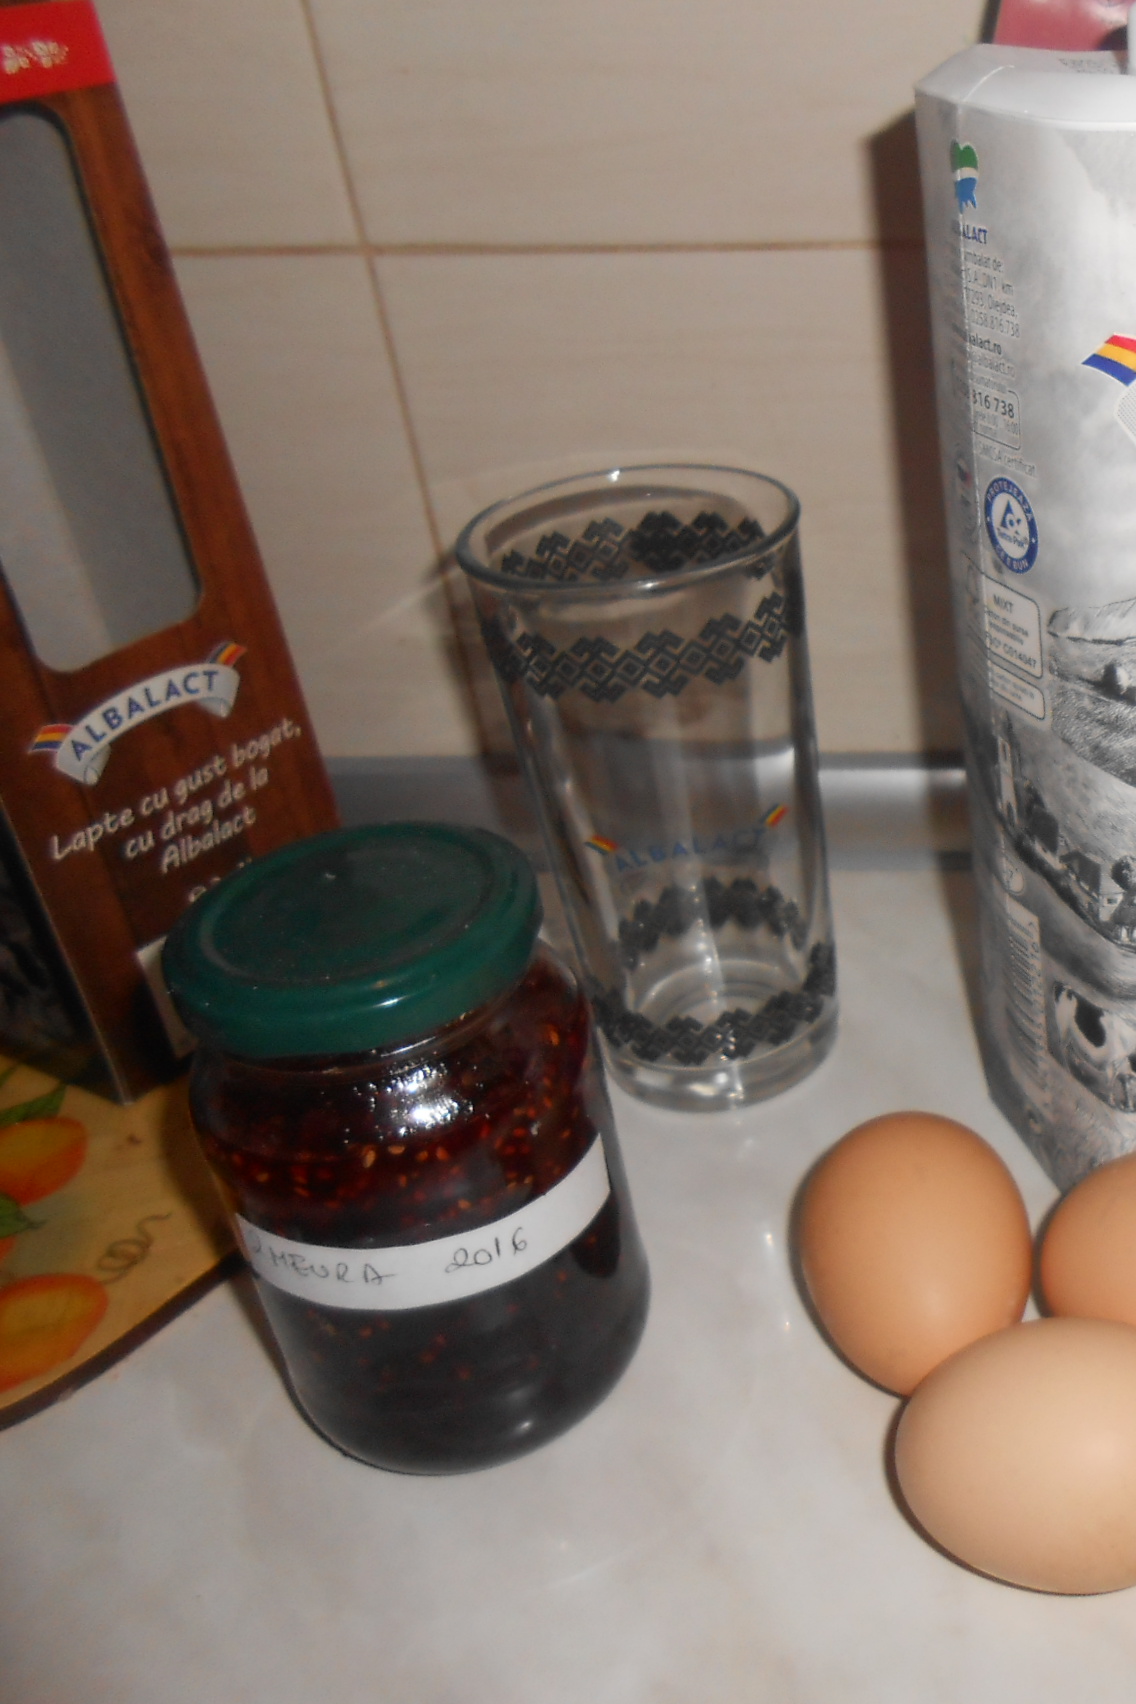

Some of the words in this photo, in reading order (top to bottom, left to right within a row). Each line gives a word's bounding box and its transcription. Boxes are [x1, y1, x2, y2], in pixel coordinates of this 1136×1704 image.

[993, 397, 1015, 419] 738
[70, 669, 220, 762] ALBALACT
[51, 808, 136, 861] Lapte
[140, 787, 170, 816] cu
[174, 754, 228, 805] gust
[124, 830, 155, 859] cu
[160, 798, 214, 841] drag
[217, 779, 247, 809] de
[250, 765, 269, 791] la
[161, 805, 257, 875] Albalact
[444, 1226, 529, 1275] 2016
